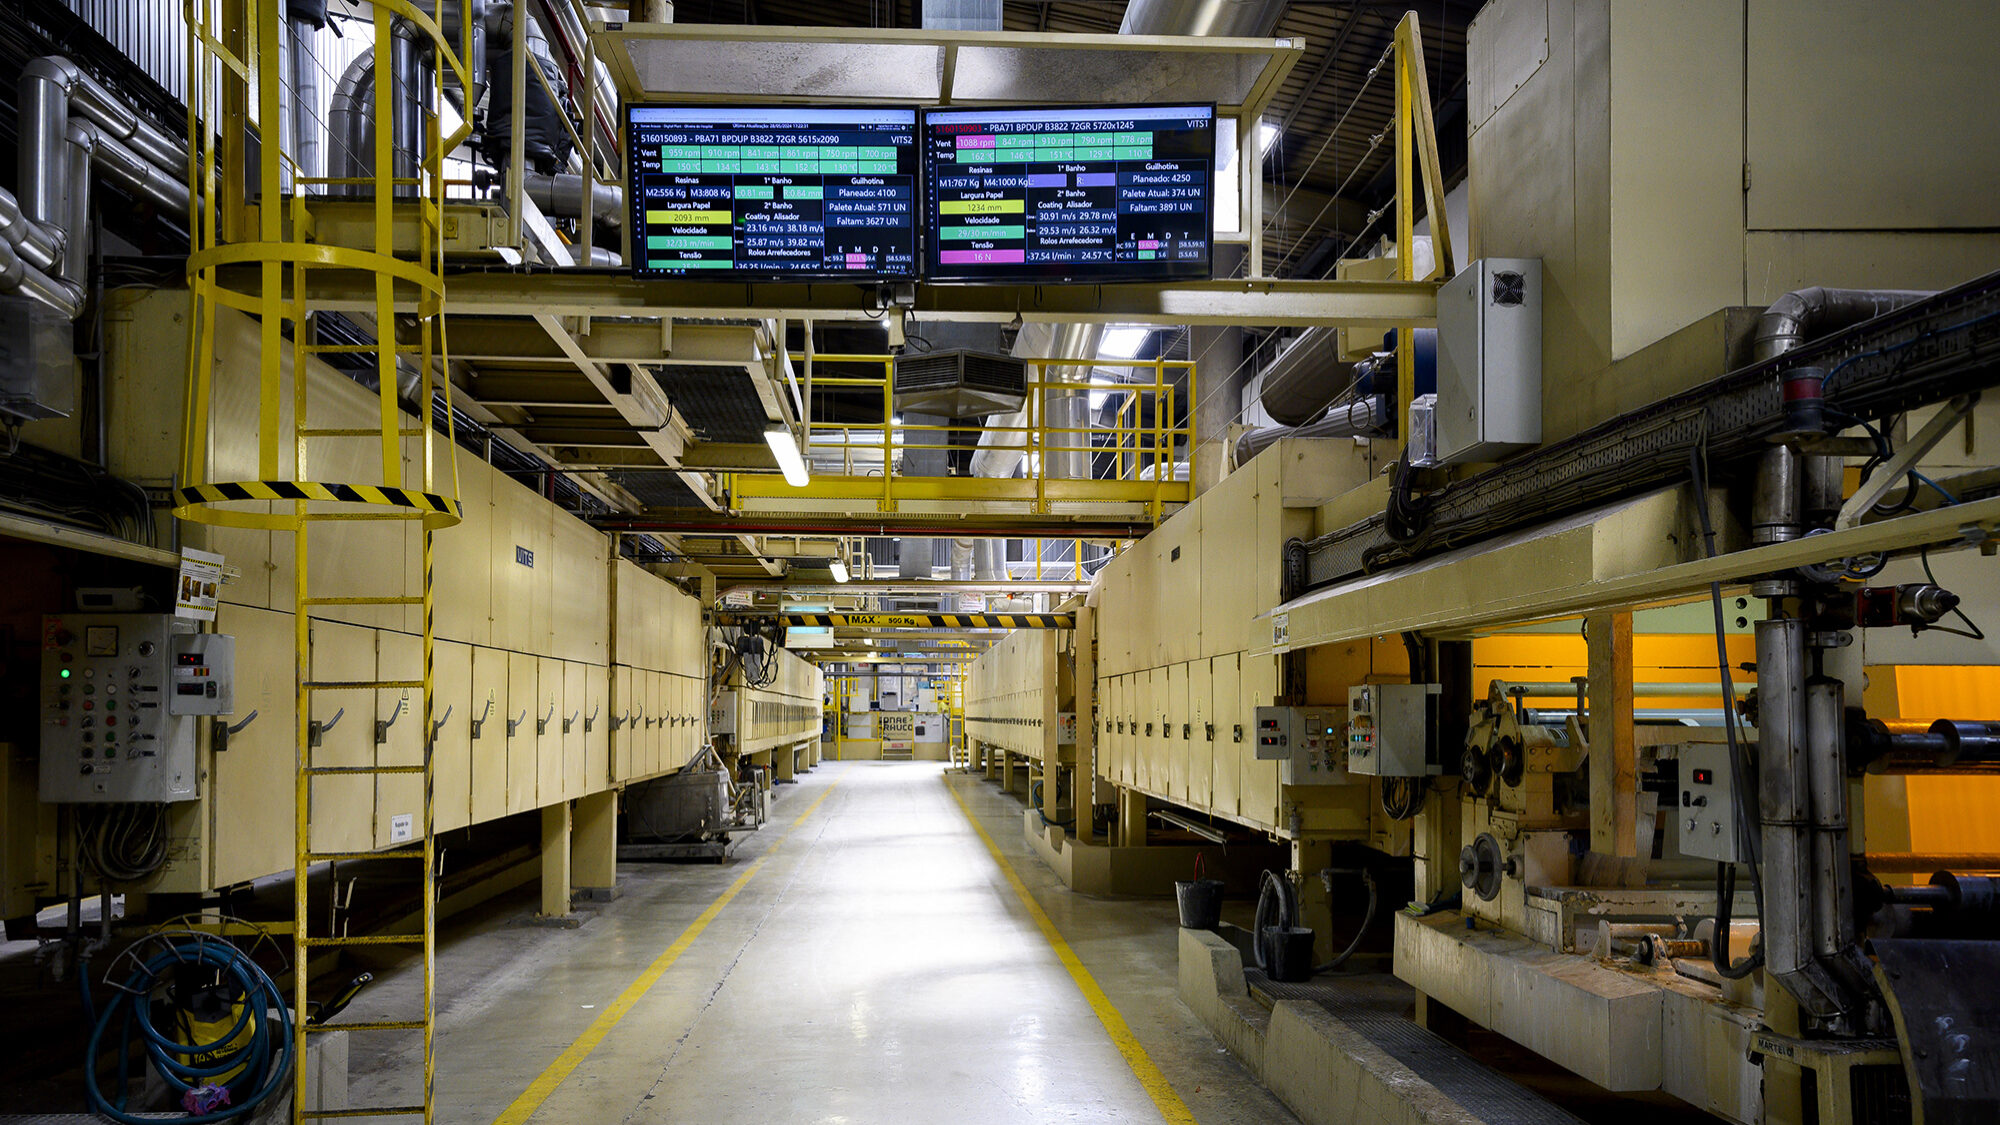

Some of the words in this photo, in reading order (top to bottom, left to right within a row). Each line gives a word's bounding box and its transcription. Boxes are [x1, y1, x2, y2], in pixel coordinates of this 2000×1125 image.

[936, 124, 982, 133] 5160150903
[1093, 121, 1134, 130] 5720x1245
[970, 179, 979, 188] Kg
[1018, 178, 1028, 187] Kg
[676, 189, 686, 198] Kg
[721, 189, 730, 198] Kg
[667, 202, 691, 210] Largura
[693, 202, 710, 210] Papel
[1038, 201, 1062, 210] Coating
[745, 213, 770, 221] Coating
[1102, 212, 1116, 220] m/s
[517, 547, 532, 567] VITS
